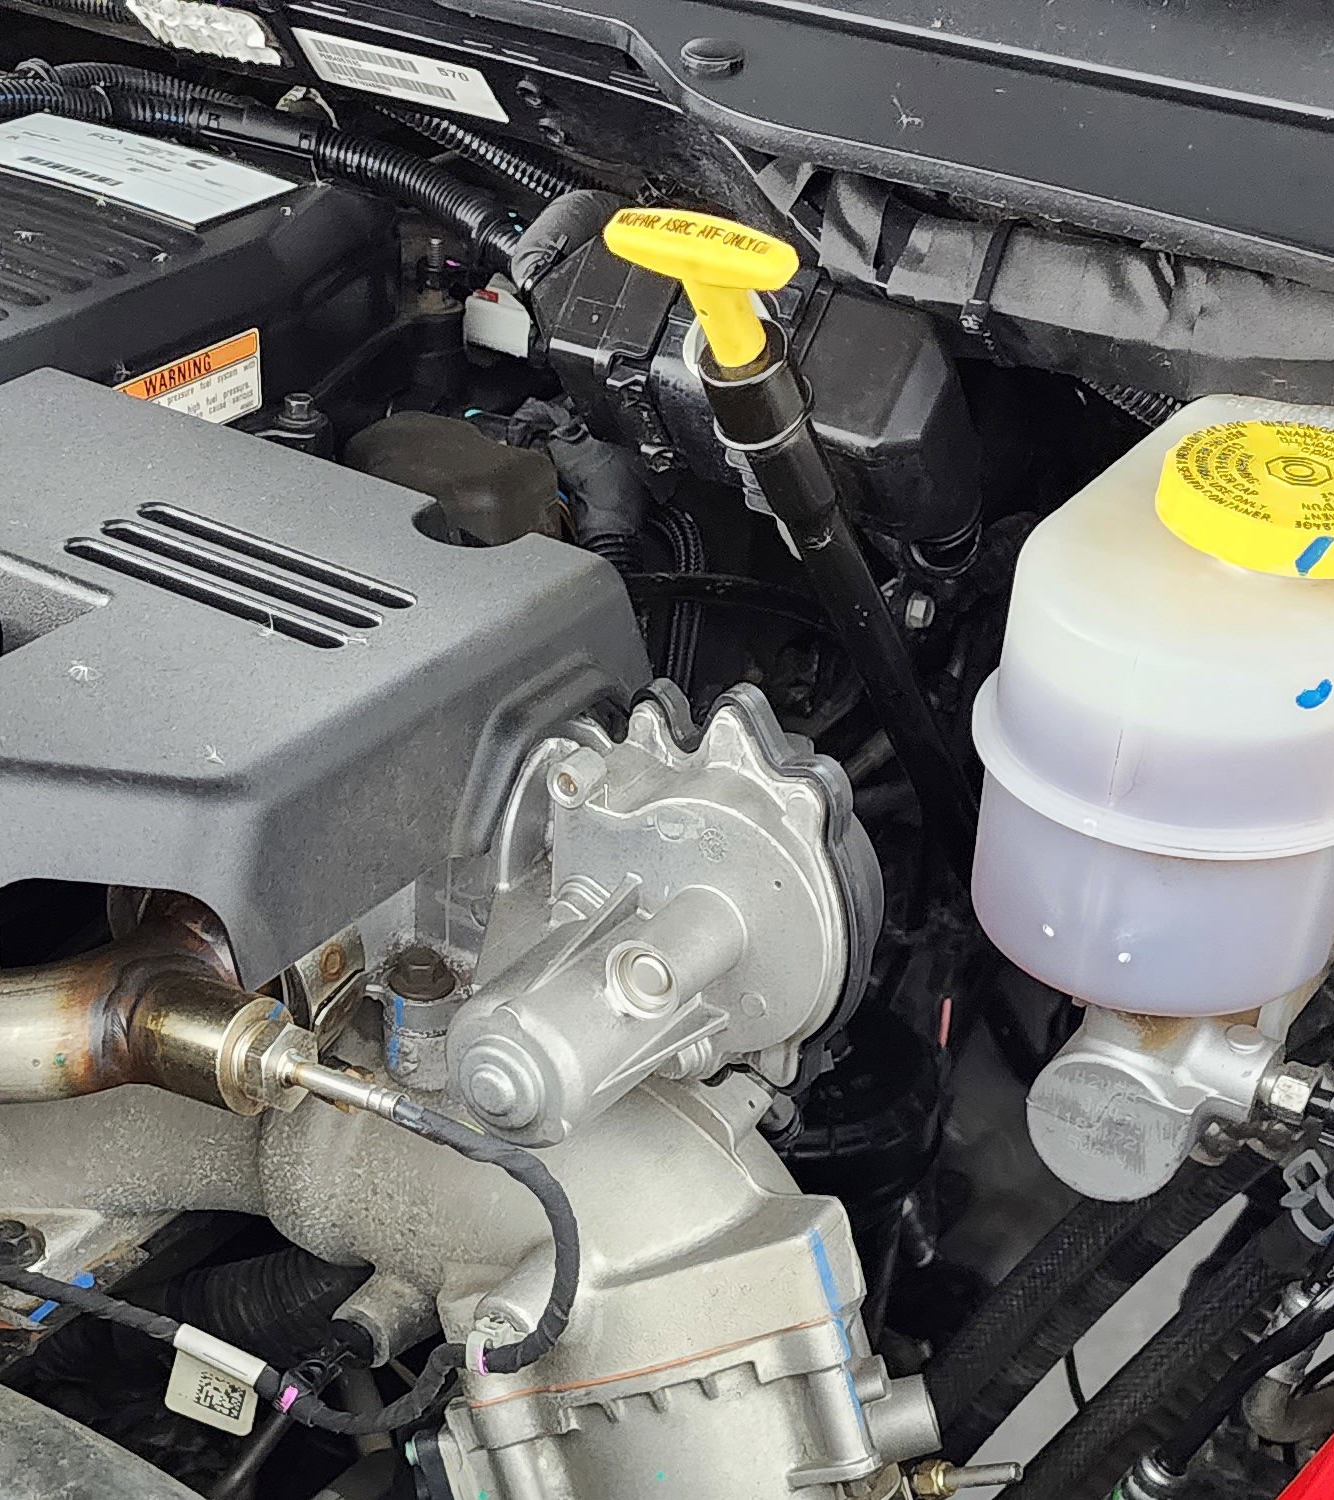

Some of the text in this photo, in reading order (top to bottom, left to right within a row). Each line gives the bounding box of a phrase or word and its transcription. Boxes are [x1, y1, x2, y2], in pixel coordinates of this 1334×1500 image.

[436, 67, 470, 82] 570
[617, 212, 661, 229] MOPAR
[697, 224, 725, 240] ATF
[144, 353, 212, 396] WARNING
[1209, 482, 1234, 495] USE
[1232, 495, 1267, 510] ONLY
[1232, 483, 1259, 495] CAP
